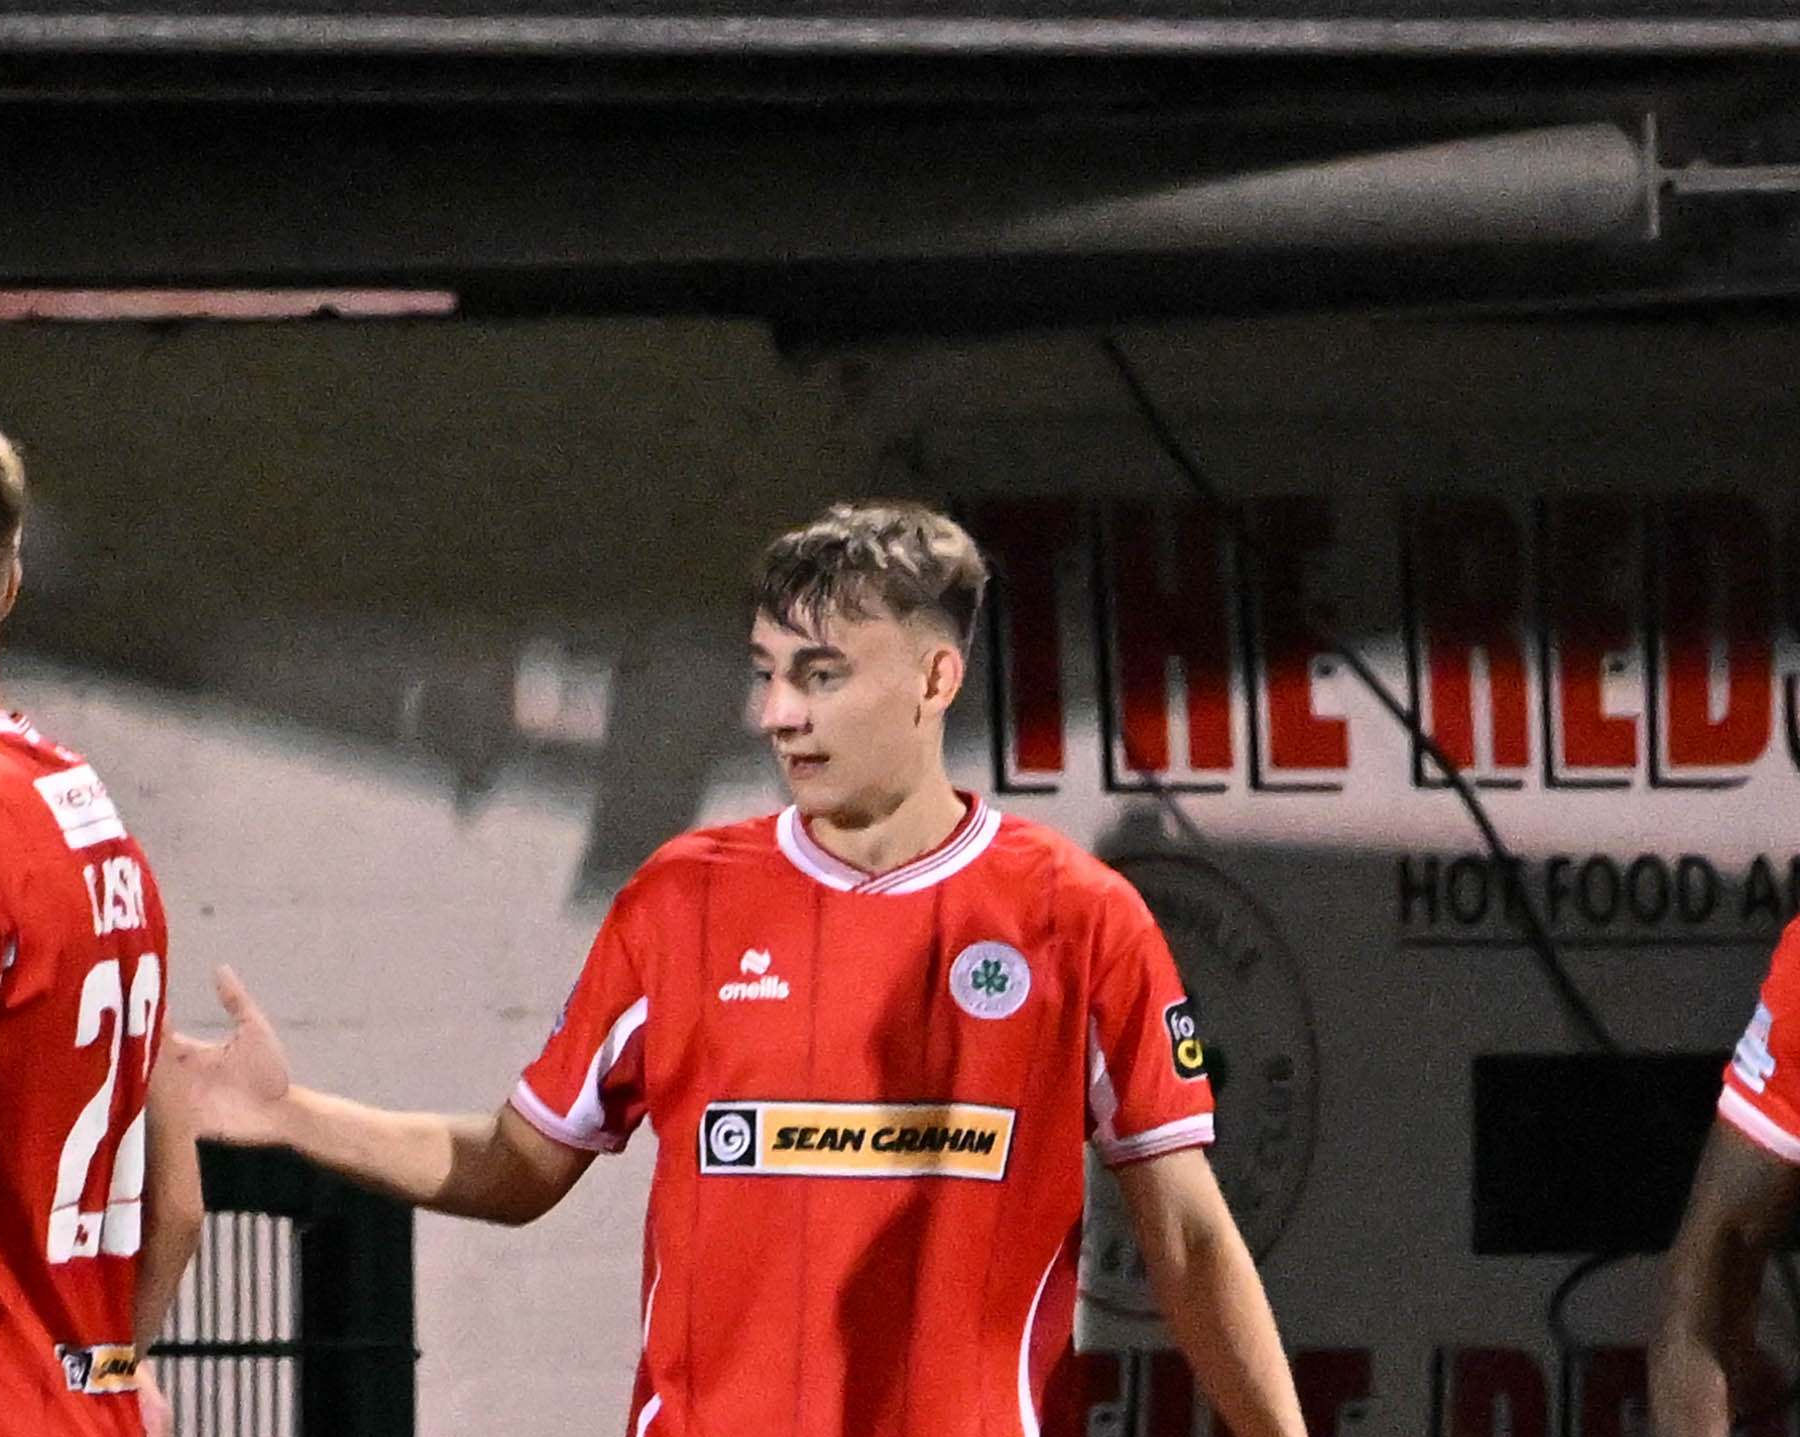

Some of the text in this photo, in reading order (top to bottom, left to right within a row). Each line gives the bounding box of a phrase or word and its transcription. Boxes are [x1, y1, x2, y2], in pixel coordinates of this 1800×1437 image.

[973, 494, 1800, 792] THE RED
[1547, 852, 1718, 925] FOOD
[46, 951, 161, 1265] 22
[771, 1126, 866, 1152] SEAN
[870, 1126, 998, 1155] GRAHAM
